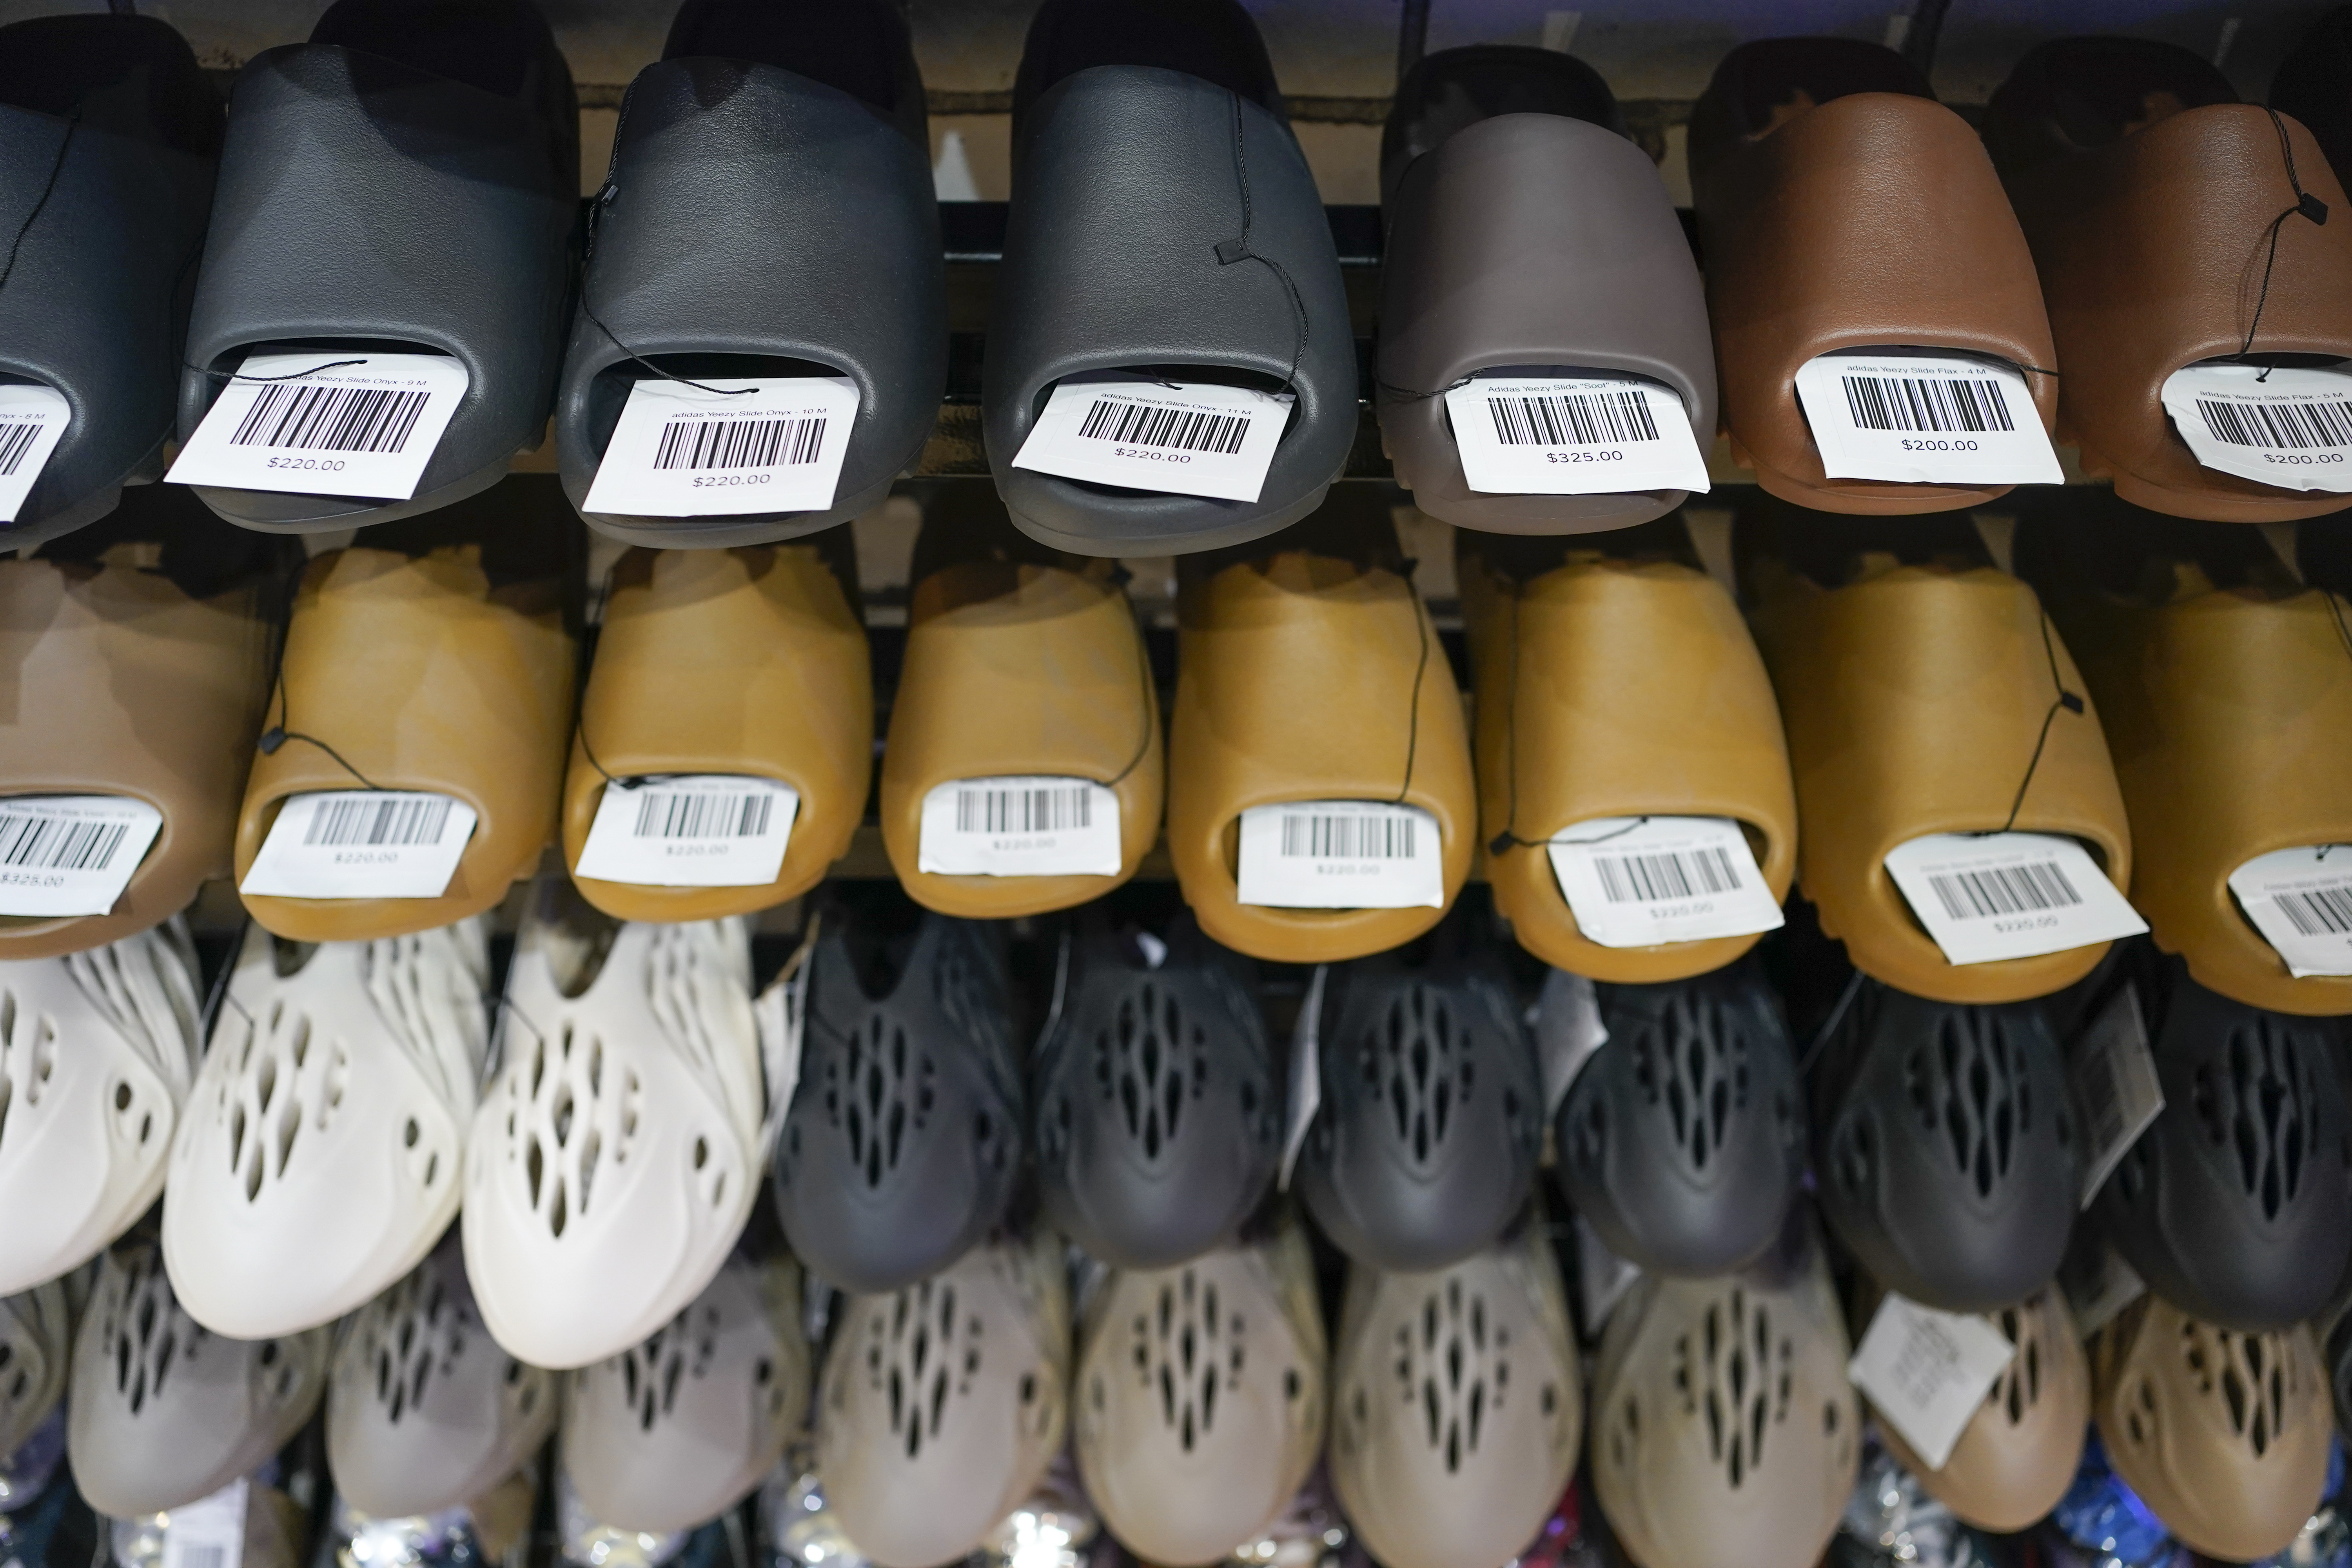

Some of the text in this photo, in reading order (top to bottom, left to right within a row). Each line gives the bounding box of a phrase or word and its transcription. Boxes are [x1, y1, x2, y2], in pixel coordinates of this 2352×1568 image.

[1101, 393, 1133, 401] adidas
[1135, 397, 1163, 405] Yeezy
[2200, 390, 2231, 399] adidas
[1902, 439, 1978, 451] $200.00
[1114, 448, 1191, 463] $220.00
[1546, 450, 1623, 464] $325.00
[2263, 454, 2344, 464] $200.00
[267, 457, 345, 471] $220.00
[692, 474, 770, 487] $220.00
[0, 872, 64, 888] $325.00
